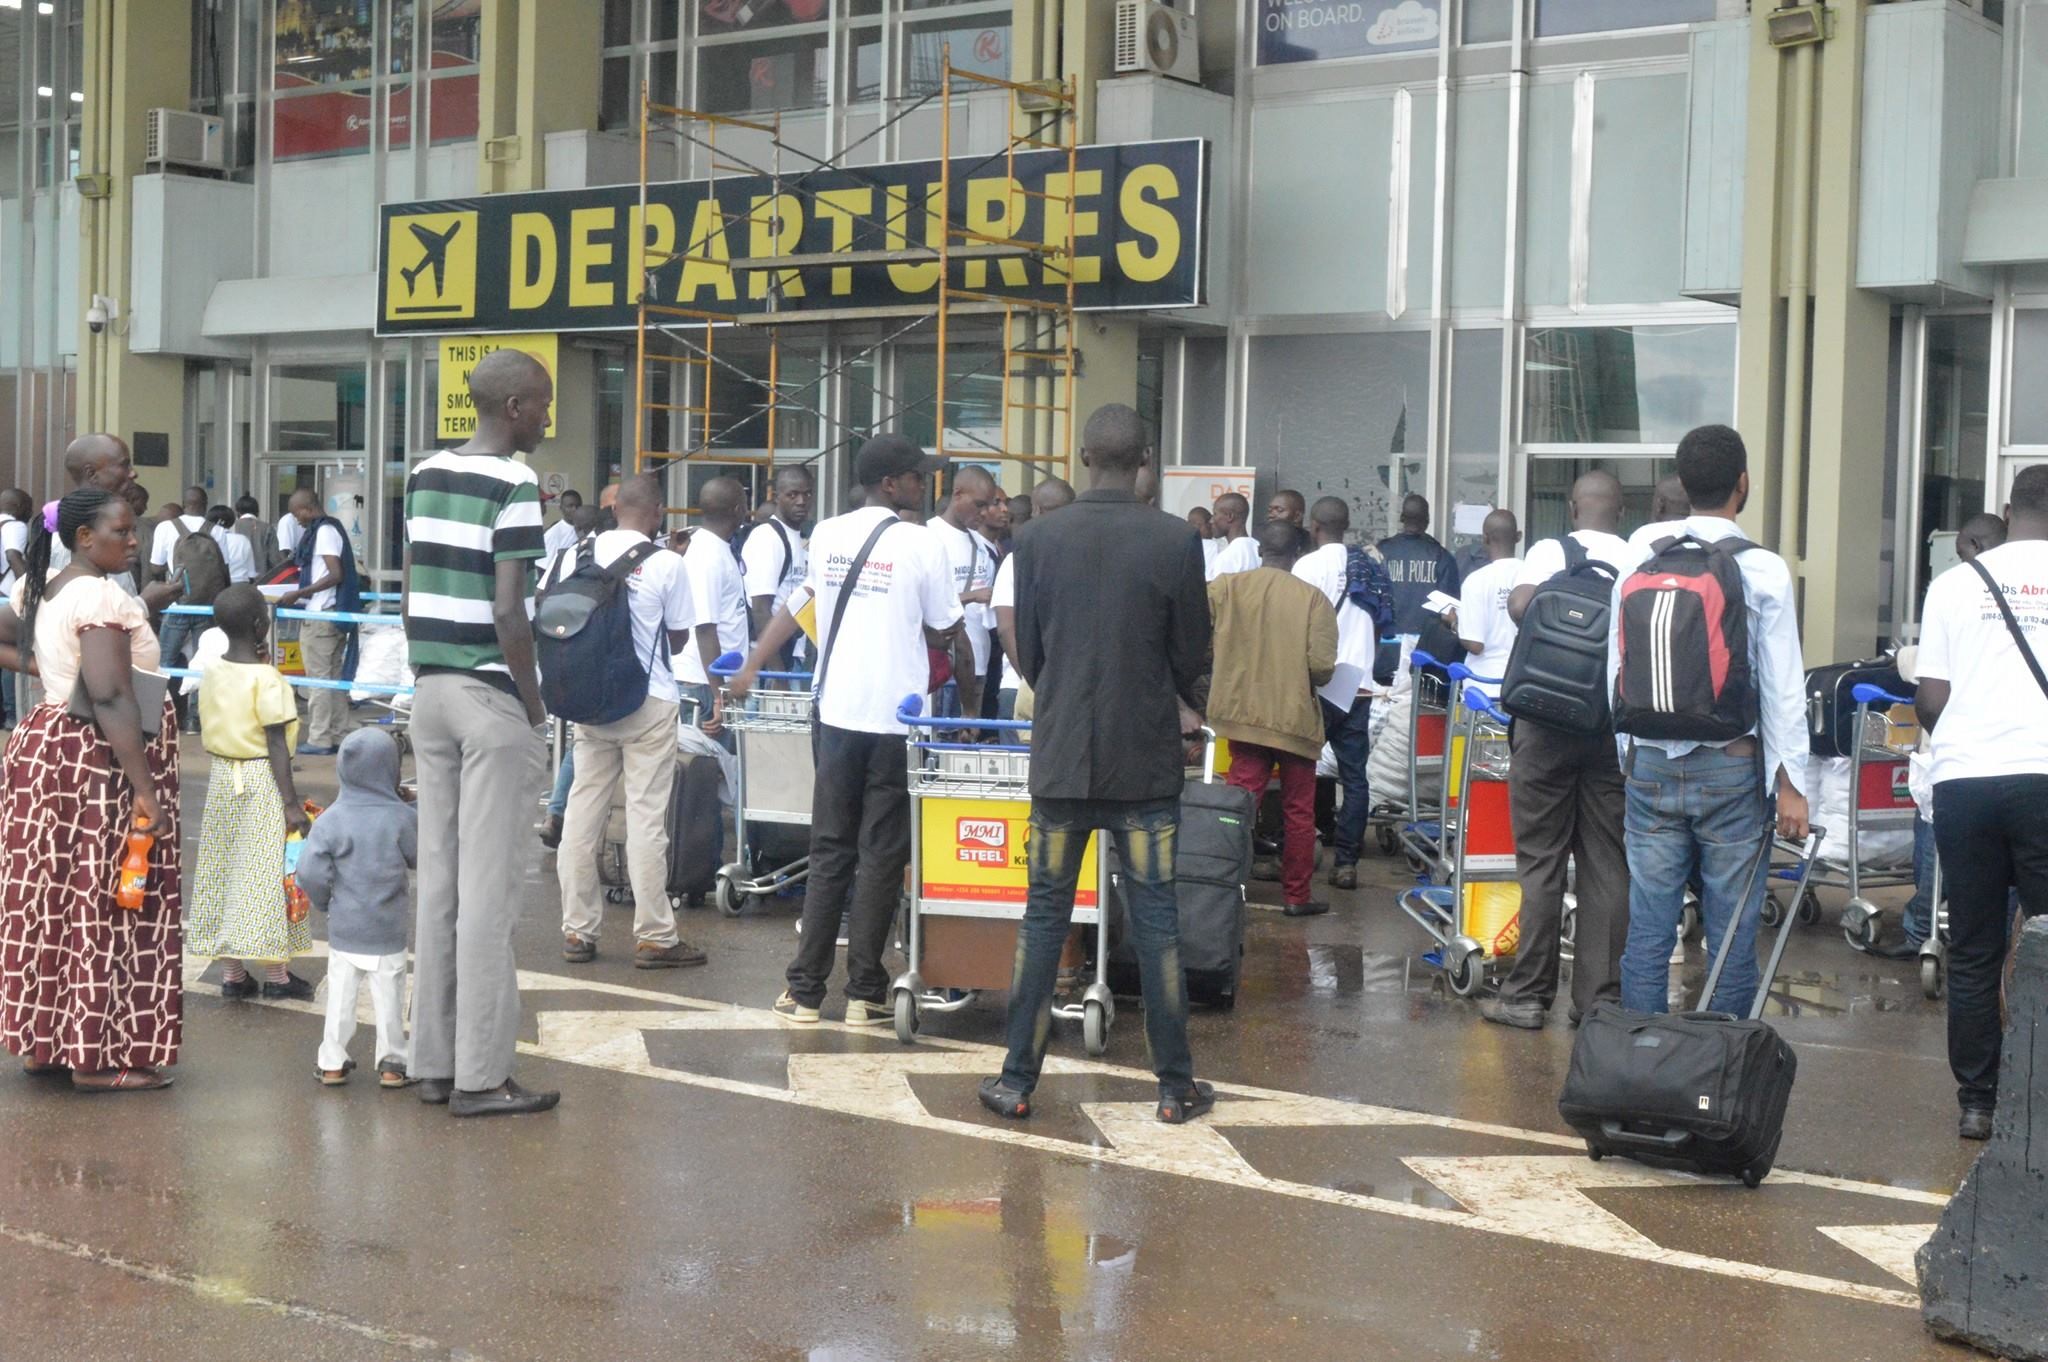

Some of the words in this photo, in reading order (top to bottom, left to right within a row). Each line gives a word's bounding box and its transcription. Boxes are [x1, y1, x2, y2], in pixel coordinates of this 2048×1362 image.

[1266, 12, 1293, 32] ON
[1298, 4, 1366, 28] BOARD.
[509, 163, 1181, 310] DEPARTURES
[449, 345, 476, 362] THIS
[447, 393, 476, 409] SMO
[444, 417, 477, 432] TERM
[826, 552, 853, 566] Jobs
[864, 559, 893, 572] broad
[1408, 559, 1438, 583] POLIC
[1984, 583, 2017, 596] Jbs
[2020, 584, 2048, 596] Abr
[963, 824, 1002, 838] MMI
[959, 849, 1004, 863] STEEL
